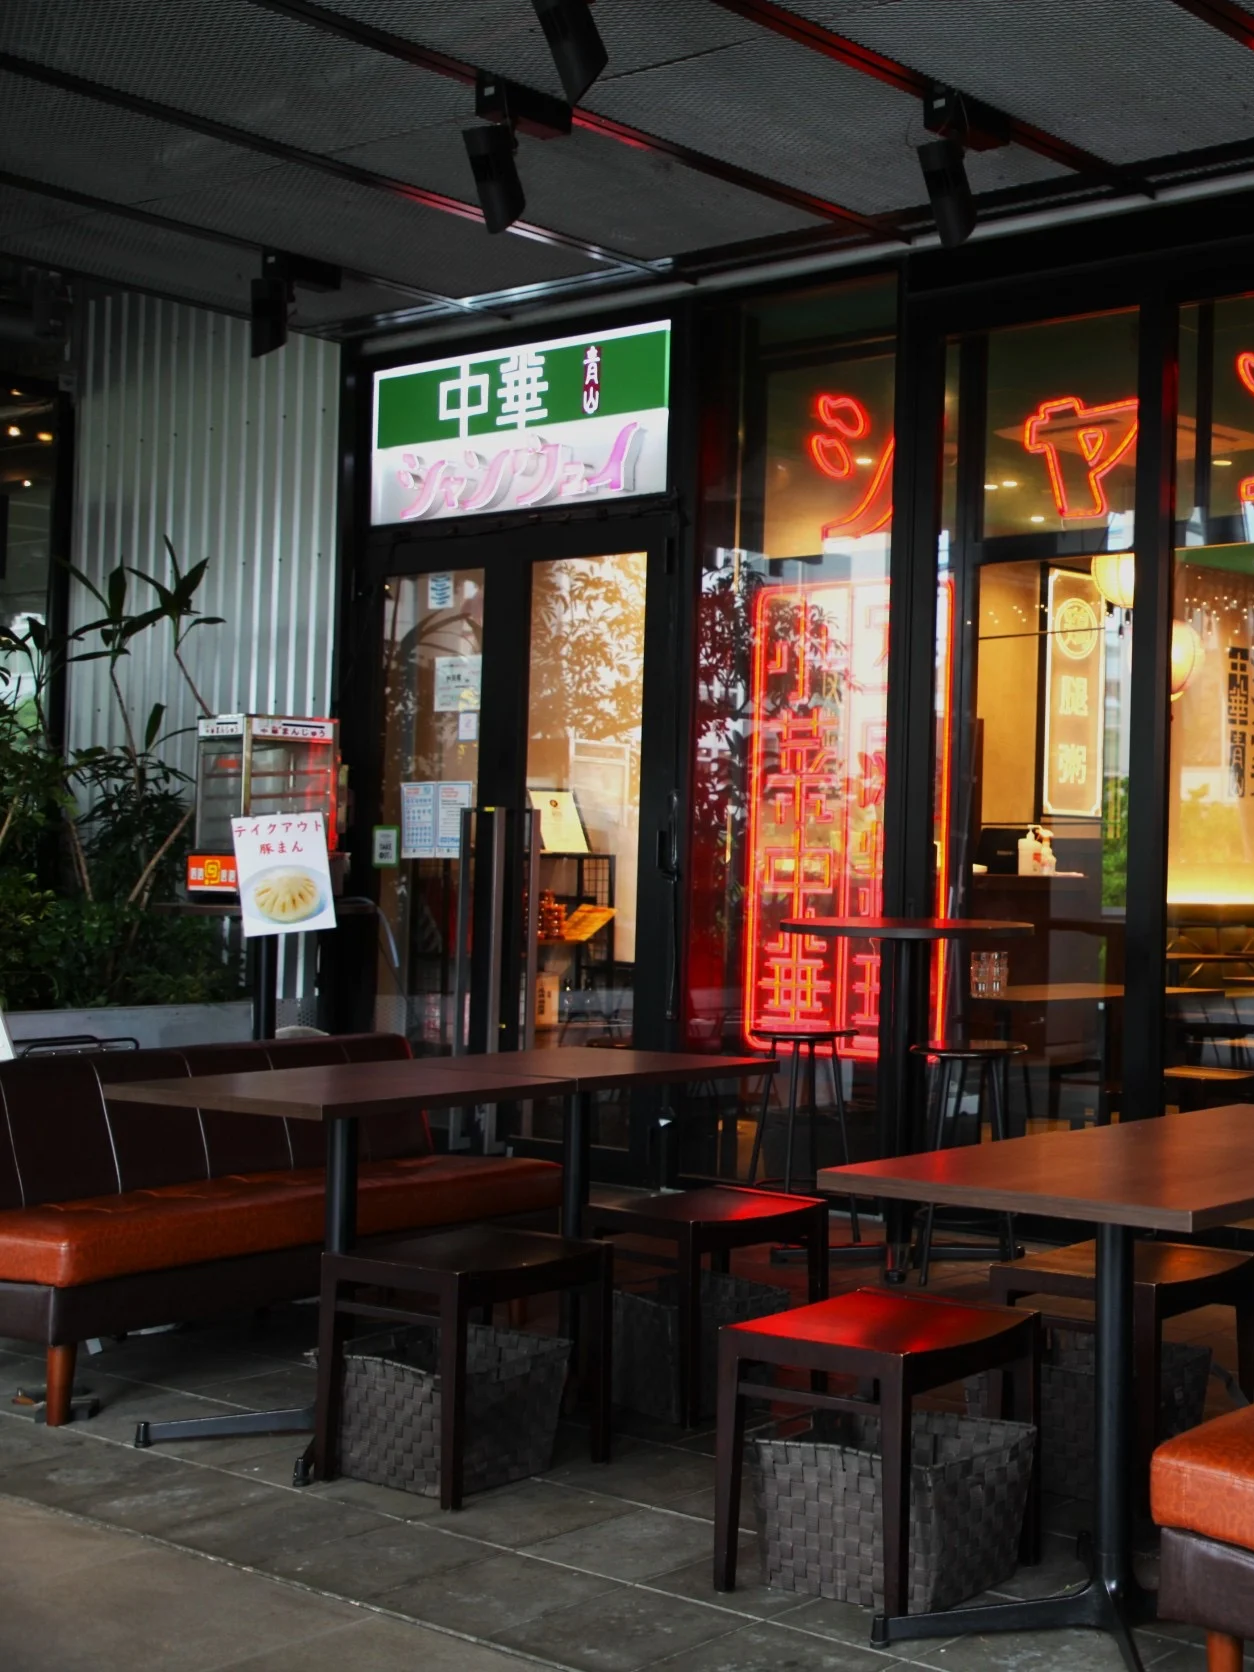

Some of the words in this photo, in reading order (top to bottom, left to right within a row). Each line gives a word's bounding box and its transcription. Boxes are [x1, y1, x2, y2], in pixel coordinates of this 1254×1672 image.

[438, 349, 549, 438] 中華
[582, 345, 601, 415] 青山
[397, 420, 644, 520] シャンウェイ
[234, 820, 322, 838] テイクアウト
[259, 840, 304, 855] 豚まん
